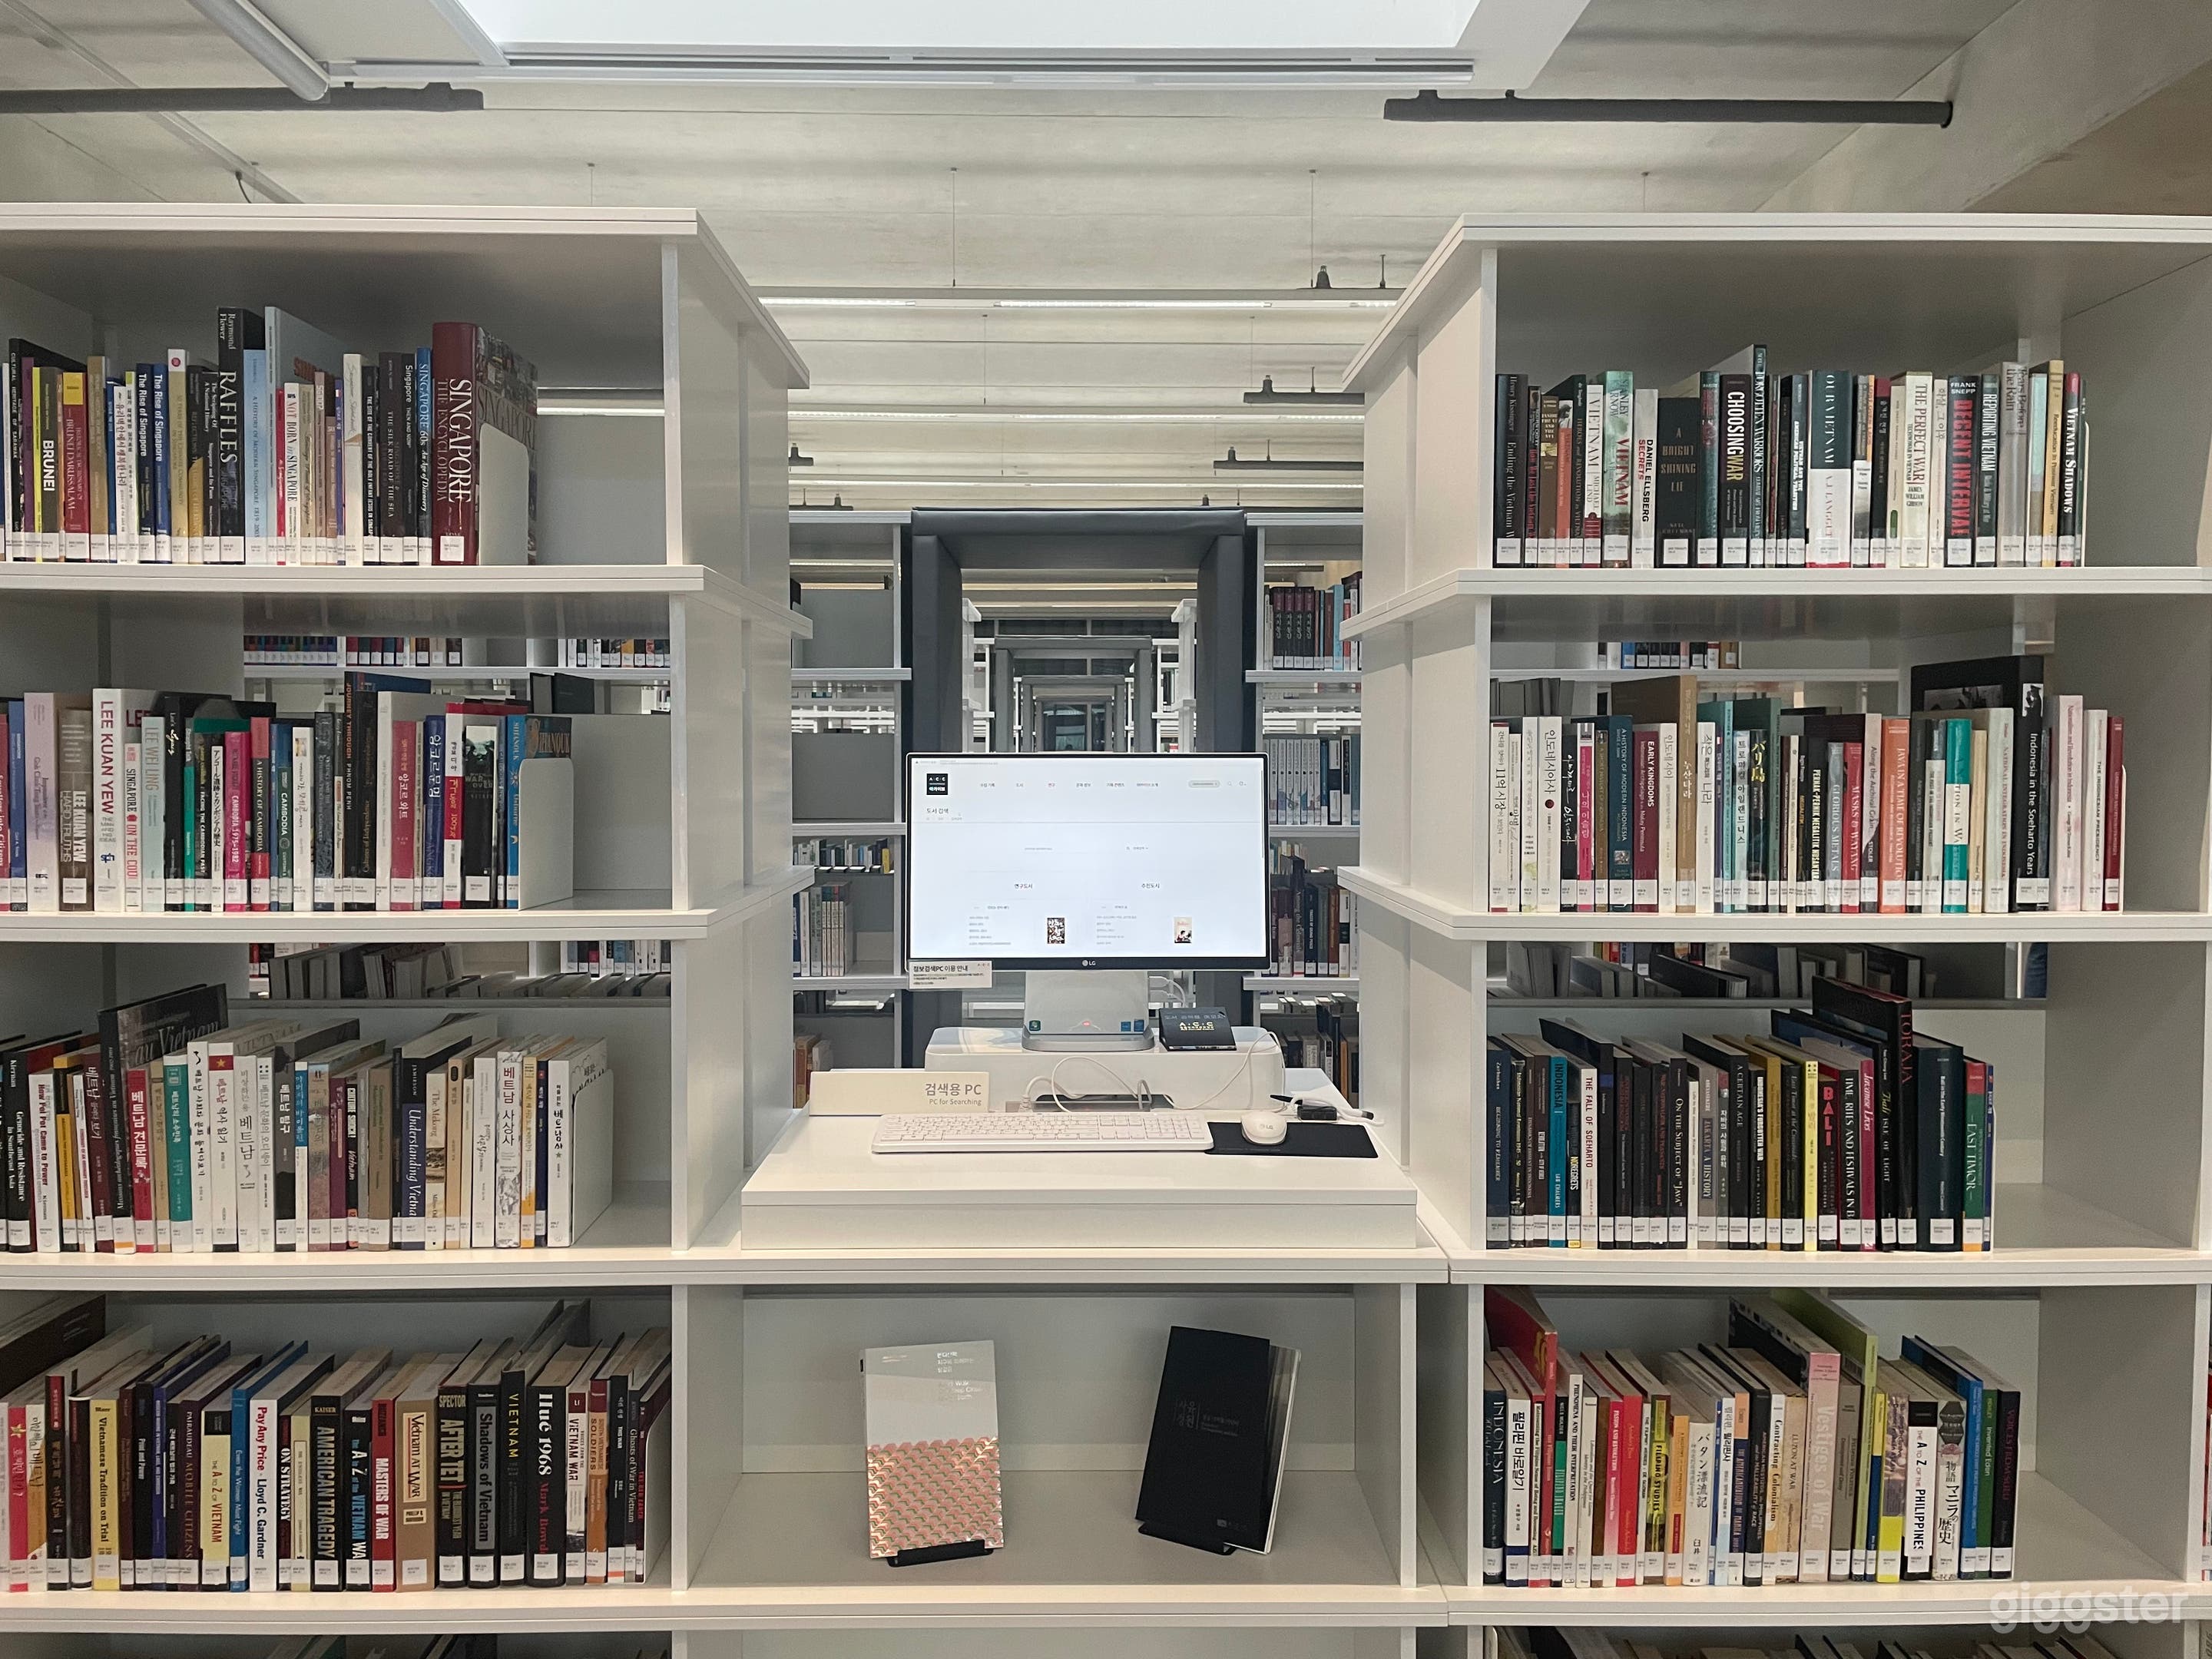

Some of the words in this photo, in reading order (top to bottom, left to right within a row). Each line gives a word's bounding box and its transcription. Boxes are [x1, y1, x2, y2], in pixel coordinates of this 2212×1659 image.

[218, 313, 227, 339] Flower
[139, 374, 147, 387] The
[154, 375, 163, 389] The
[2005, 369, 2015, 385] the
[1915, 384, 1927, 405] THE
[2005, 387, 2015, 411] Rain
[155, 410, 163, 419] of
[220, 372, 237, 463] RAFFLES
[287, 402, 296, 418] NOT
[1982, 394, 1997, 435] REPORTING
[139, 418, 147, 456] Singapore
[154, 421, 163, 462] Singapore
[449, 379, 472, 502] SINGAPORE
[1913, 408, 1926, 454] PERFECT
[1952, 399, 1972, 458] DECENT
[2065, 408, 2078, 455] VIETNAM
[287, 446, 295, 455] in
[1981, 438, 1995, 471] VIETNAM
[43, 440, 55, 491] BRUNEI
[287, 455, 297, 501] SINGAPORE
[1614, 438, 1629, 506] VIETNAM
[1912, 458, 1926, 481] WAR
[1642, 475, 1651, 522] ELLSBERG
[1950, 463, 1972, 535] INTERVAL
[2063, 460, 2077, 513] SHADOWS
[101, 701, 114, 729] LEE
[145, 727, 159, 743] LEE
[101, 733, 114, 776] KUAN
[146, 747, 159, 765] WEI
[1621, 763, 1627, 772] OF
[2028, 733, 2038, 777] Indonesia
[146, 769, 159, 790] LING
[399, 774, 409, 800] 앙코르
[2029, 780, 2037, 788] in
[63, 791, 72, 820] HARD
[73, 790, 86, 807] LEE
[101, 780, 114, 813] YEW
[257, 800, 263, 809] OF
[399, 802, 409, 819] 와트
[2028, 790, 2037, 806] the
[73, 809, 86, 836] KUAN
[2027, 809, 2036, 849] Soeharto
[63, 823, 72, 862] TRUTHS
[73, 838, 87, 863] YEW
[2026, 851, 2035, 875] Years
[502, 1068, 515, 1104] 베트남
[925, 1082, 962, 1097] 검색용
[965, 1084, 982, 1095] PC
[1863, 1073, 1873, 1108] Javanese
[949, 1098, 982, 1108] Searching
[1823, 1087, 1834, 1146] BALI
[16, 1111, 25, 1144] Genocide
[502, 1110, 515, 1146] 사상사
[1586, 1117, 1592, 1125] OF
[1864, 1111, 1873, 1131] Lives
[1967, 1123, 1976, 1148] EAST
[17, 1162, 25, 1200] Resistance
[1570, 1164, 1578, 1190] REGRETS
[1703, 1164, 1712, 1198] HISTORY
[1966, 1154, 1976, 1190] TIMOR
[257, 1407, 267, 1424] Pay
[508, 1394, 519, 1458] VIETNAM
[1512, 1412, 1525, 1444] 필리핀
[257, 1426, 267, 1443] Any
[479, 1413, 492, 1469] Shadows
[1493, 1401, 1505, 1483] INDONESIA
[1723, 1433, 1731, 1461] 필리핀사
[1773, 1420, 1783, 1469] Contracting
[1814, 1406, 1834, 1474] Vestiges
[257, 1445, 267, 1470] Price
[280, 1448, 290, 1463] ON
[316, 1427, 335, 1497] AMERICAN
[1513, 1448, 1525, 1491] 바로알기
[1790, 1461, 1797, 1470] AT
[257, 1479, 267, 1504] Lloyd
[280, 1467, 290, 1521] STRATEGY
[375, 1459, 389, 1501] MASTERS
[479, 1474, 492, 1486] of
[1814, 1480, 1828, 1495] of
[376, 1505, 388, 1515] OF
[1770, 1474, 1780, 1521] Colonialism
[257, 1507, 267, 1517] C.
[478, 1489, 492, 1541] Vietnam
[1812, 1502, 1830, 1530] War
[257, 1519, 267, 1558] Gardner
[317, 1500, 335, 1557] TRAGEDY
[376, 1518, 389, 1539] WAR
